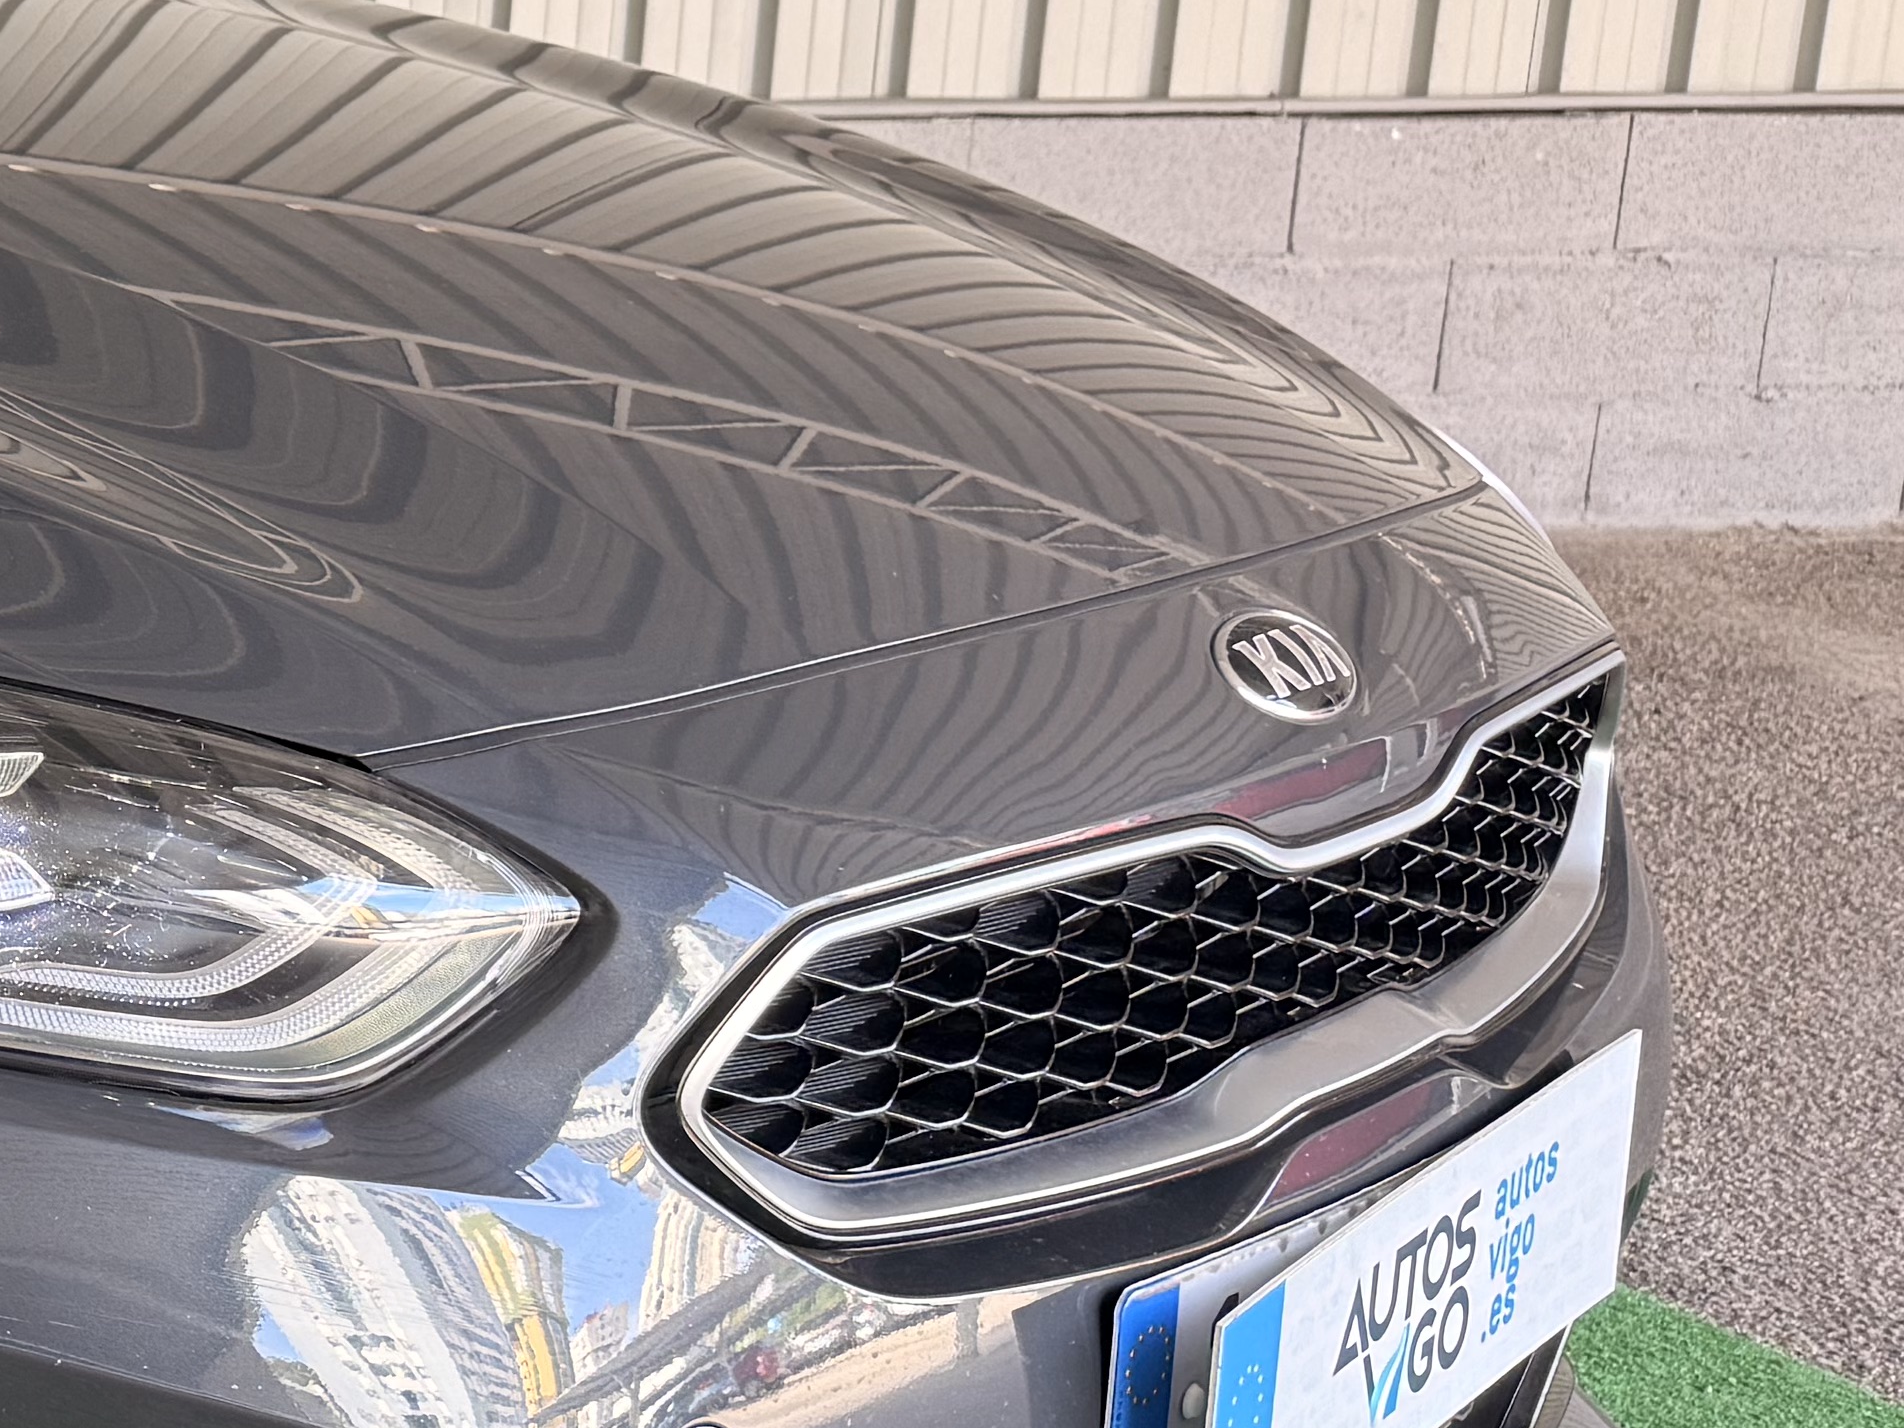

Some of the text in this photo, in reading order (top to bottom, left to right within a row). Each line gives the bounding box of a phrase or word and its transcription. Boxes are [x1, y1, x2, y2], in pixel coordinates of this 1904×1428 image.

[1232, 624, 1352, 699] KIA
[1494, 1140, 1560, 1220] autos
[1332, 1188, 1483, 1377] AUTOS
[1489, 1212, 1535, 1285] vigo
[1480, 1282, 1517, 1344] .es
[1363, 1285, 1470, 1428] VIGO
